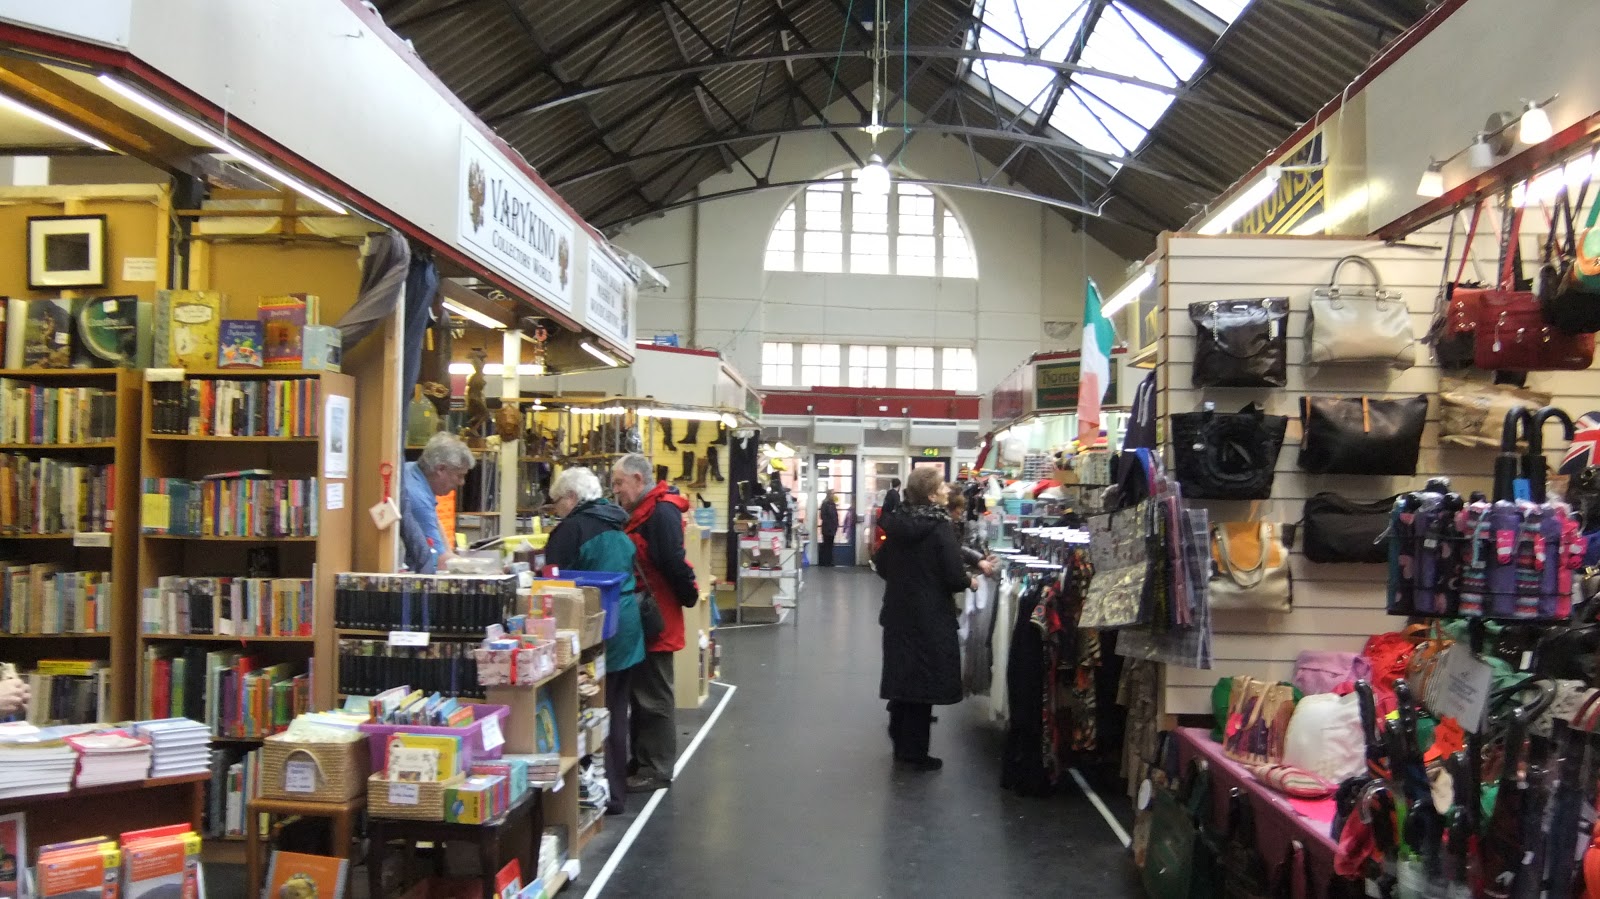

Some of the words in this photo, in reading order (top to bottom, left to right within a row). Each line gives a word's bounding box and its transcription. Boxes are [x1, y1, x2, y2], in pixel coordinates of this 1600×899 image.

[491, 178, 556, 262] VARYKINO
[492, 229, 531, 269] COLLECTORS
[532, 257, 553, 284] WORLD
